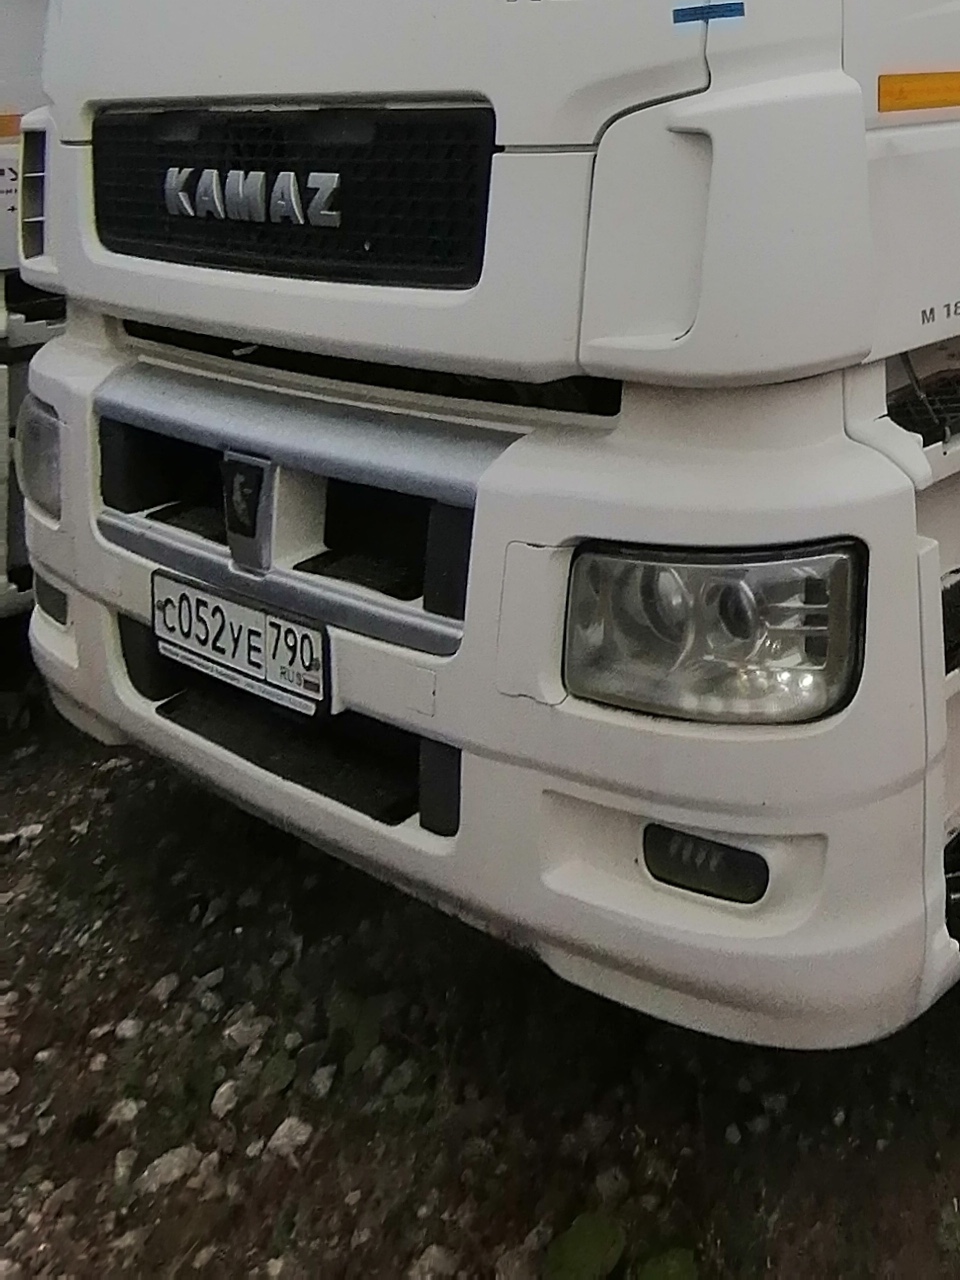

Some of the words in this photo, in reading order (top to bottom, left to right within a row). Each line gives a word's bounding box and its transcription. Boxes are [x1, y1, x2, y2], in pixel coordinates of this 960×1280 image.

[164, 167, 342, 229] KAMAZ
[921, 306, 936, 326] M
[268, 620, 314, 672] 790
